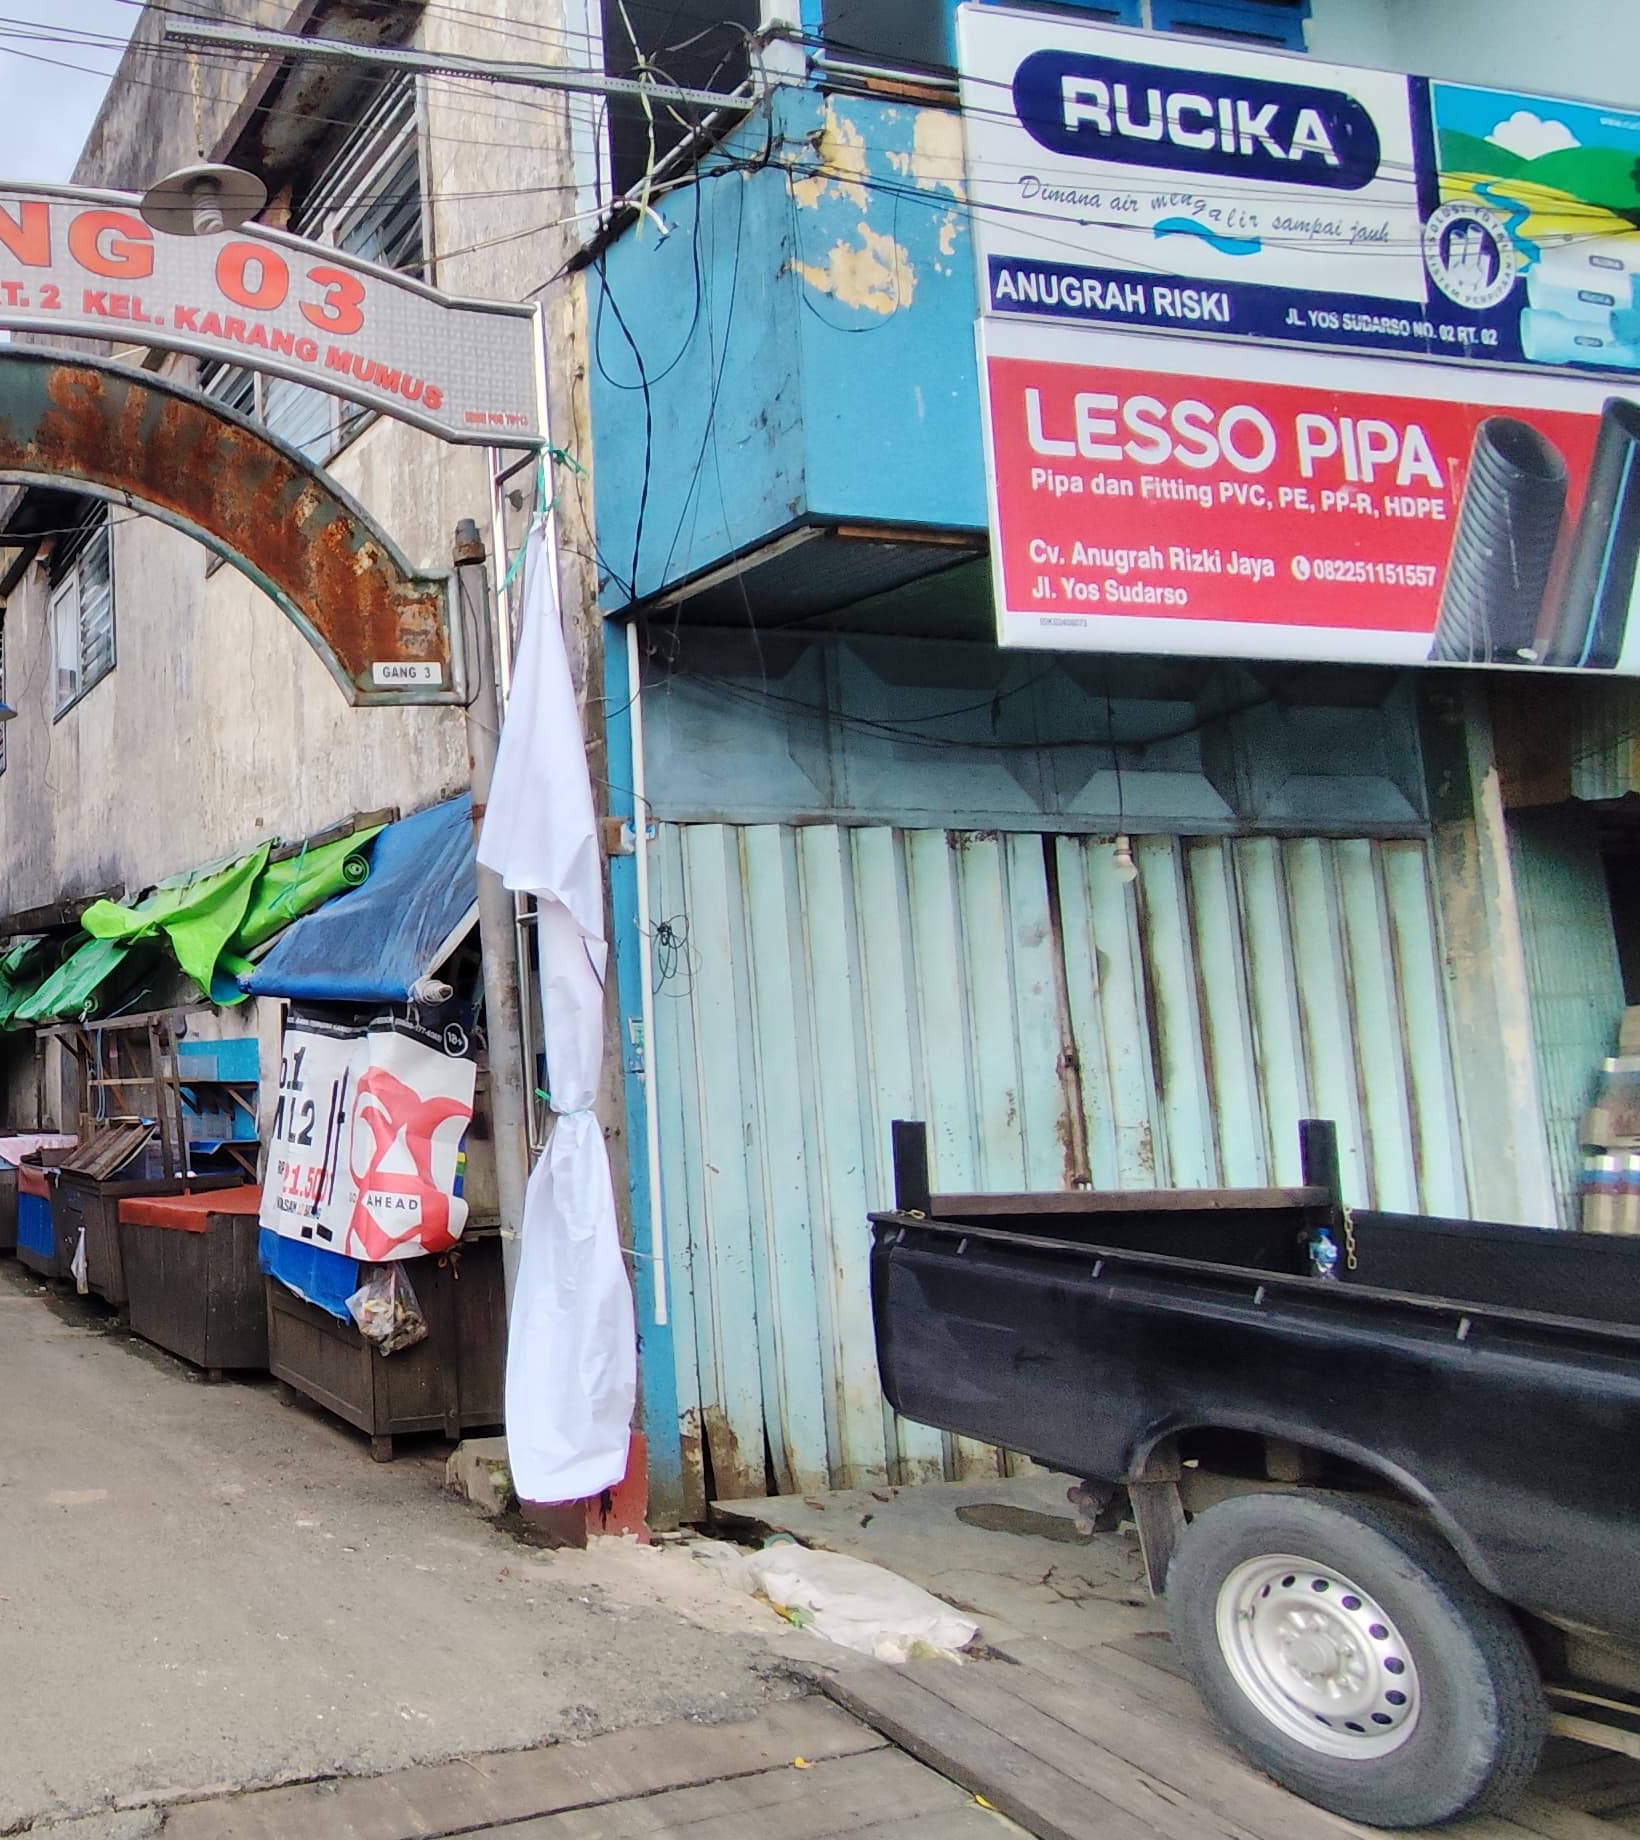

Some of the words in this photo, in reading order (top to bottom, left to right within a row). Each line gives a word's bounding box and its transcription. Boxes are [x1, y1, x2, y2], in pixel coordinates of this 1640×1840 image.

[1059, 74, 1342, 165] RUCIKA
[1018, 174, 1102, 207] Dimana
[1109, 194, 1139, 213] air
[1271, 214, 1341, 240] sampai
[1348, 221, 1390, 245] jauh
[215, 242, 366, 336] 03
[996, 268, 1146, 314] ANUGRAH
[1152, 286, 1230, 322] RISKI
[39, 282, 62, 309] 2
[82, 289, 165, 325] KEL.
[174, 304, 318, 364] KARANG
[324, 345, 445, 411] MUMUS
[1308, 310, 1339, 330] YOS
[1342, 313, 1410, 336] SUDARSO
[1439, 323, 1456, 342] 02
[1457, 326, 1478, 344] RT.
[1480, 328, 1499, 345] 02
[1025, 387, 1276, 474] LESSO
[1295, 413, 1445, 489] PIPA
[1031, 467, 1084, 496] Pipa
[1091, 473, 1134, 498] dan
[1141, 476, 1213, 508] Fitting
[1219, 482, 1273, 511] PVC,
[1279, 486, 1316, 513] PE,
[1321, 489, 1379, 518] PP-R,
[1384, 495, 1447, 520] HDPE
[1029, 538, 1065, 565] Cv.
[1071, 541, 1165, 574] Anugrah
[1169, 546, 1222, 574] Rizki
[1226, 549, 1275, 583] Jaya
[1313, 562, 1437, 588] 082251151557
[1031, 575, 1057, 600] Jl.
[1062, 577, 1099, 601] Yos
[1104, 580, 1188, 605] Sudarso
[382, 666, 417, 679] GANG
[424, 667, 431, 679] 3
[367, 1195, 419, 1211] AHEAD
